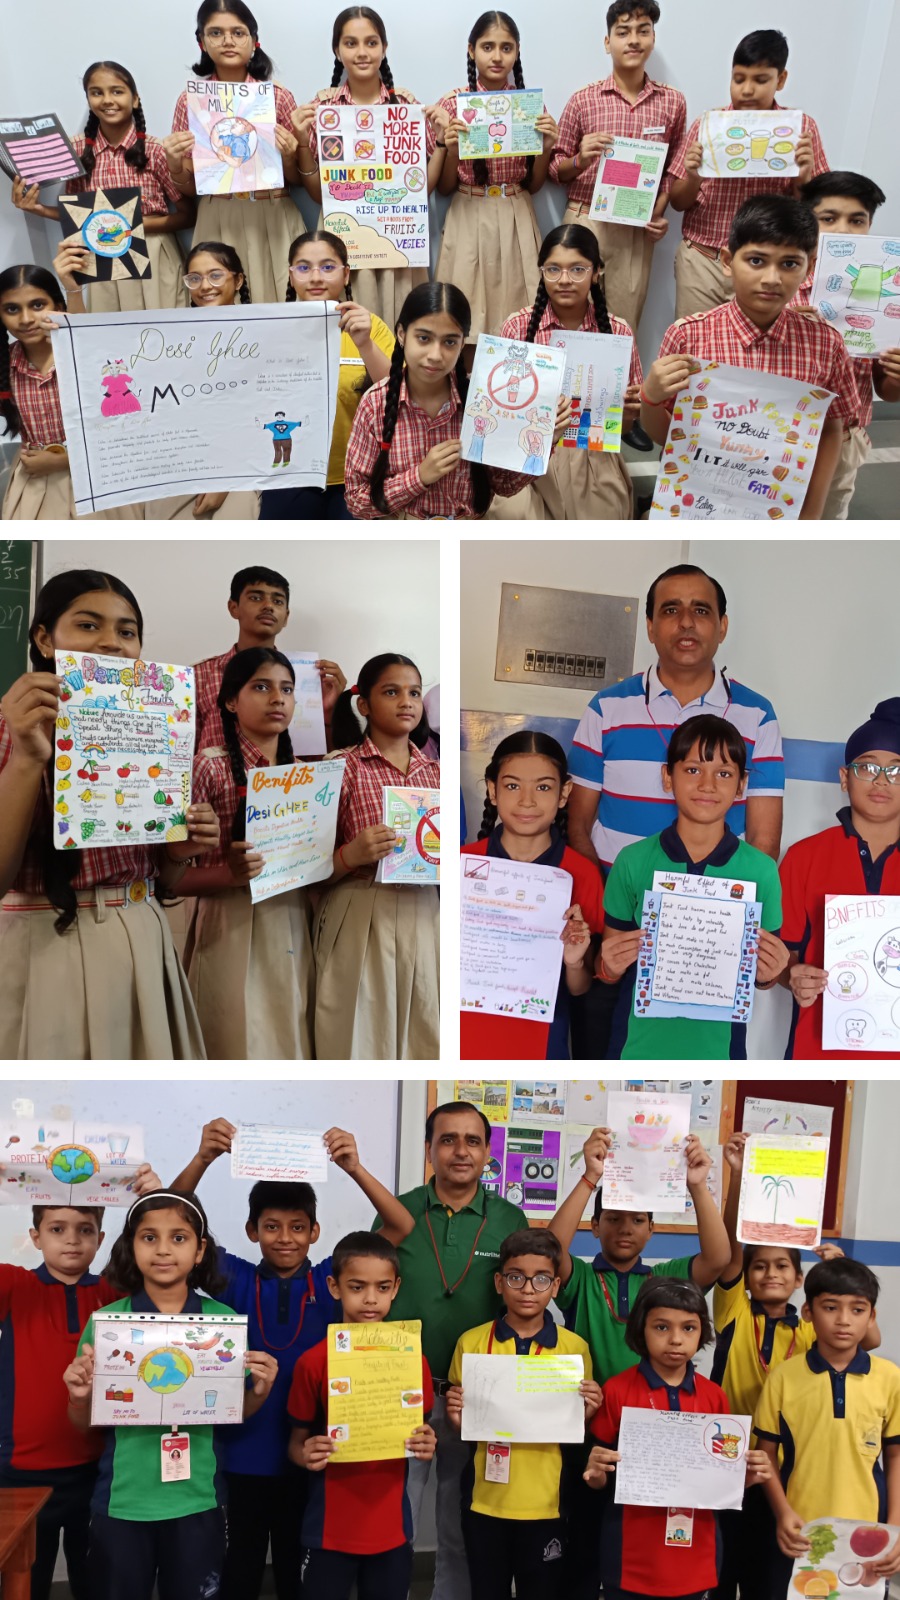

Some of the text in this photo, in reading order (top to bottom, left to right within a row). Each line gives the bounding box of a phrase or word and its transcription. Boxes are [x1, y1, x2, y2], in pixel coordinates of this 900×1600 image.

[187, 80, 271, 97] BENIFITS OF
[208, 98, 233, 112] MILK
[388, 107, 408, 121] NO
[383, 121, 420, 136] MORE
[383, 136, 421, 151] JUNK
[385, 150, 420, 165] FOOD
[323, 168, 392, 182] JUNK FOOD
[356, 206, 375, 214] RISE
[378, 205, 389, 214] UP
[403, 205, 428, 213] HEALTH
[384, 223, 425, 234] FRUITS &
[395, 239, 426, 249] VEGIES
[131, 326, 261, 377] Desi Ghee
[761, 402, 791, 433] Food
[715, 419, 770, 440] no Doubt
[730, 460, 748, 472] will
[748, 480, 770, 495] FAT
[3, 567, 26, 579] 35
[81, 655, 175, 692] Benefits
[140, 687, 175, 706] Fruits
[79, 709, 99, 717] Nature
[78, 722, 100, 732] Special
[110, 719, 130, 730] things
[252, 765, 315, 794] Benifits
[246, 800, 309, 823] Desi GHEE
[665, 873, 729, 889] Harmful Effect of
[719, 909, 732, 917] health
[703, 971, 711, 979] fat
[10, 1154, 48, 1164] PROTEIN
